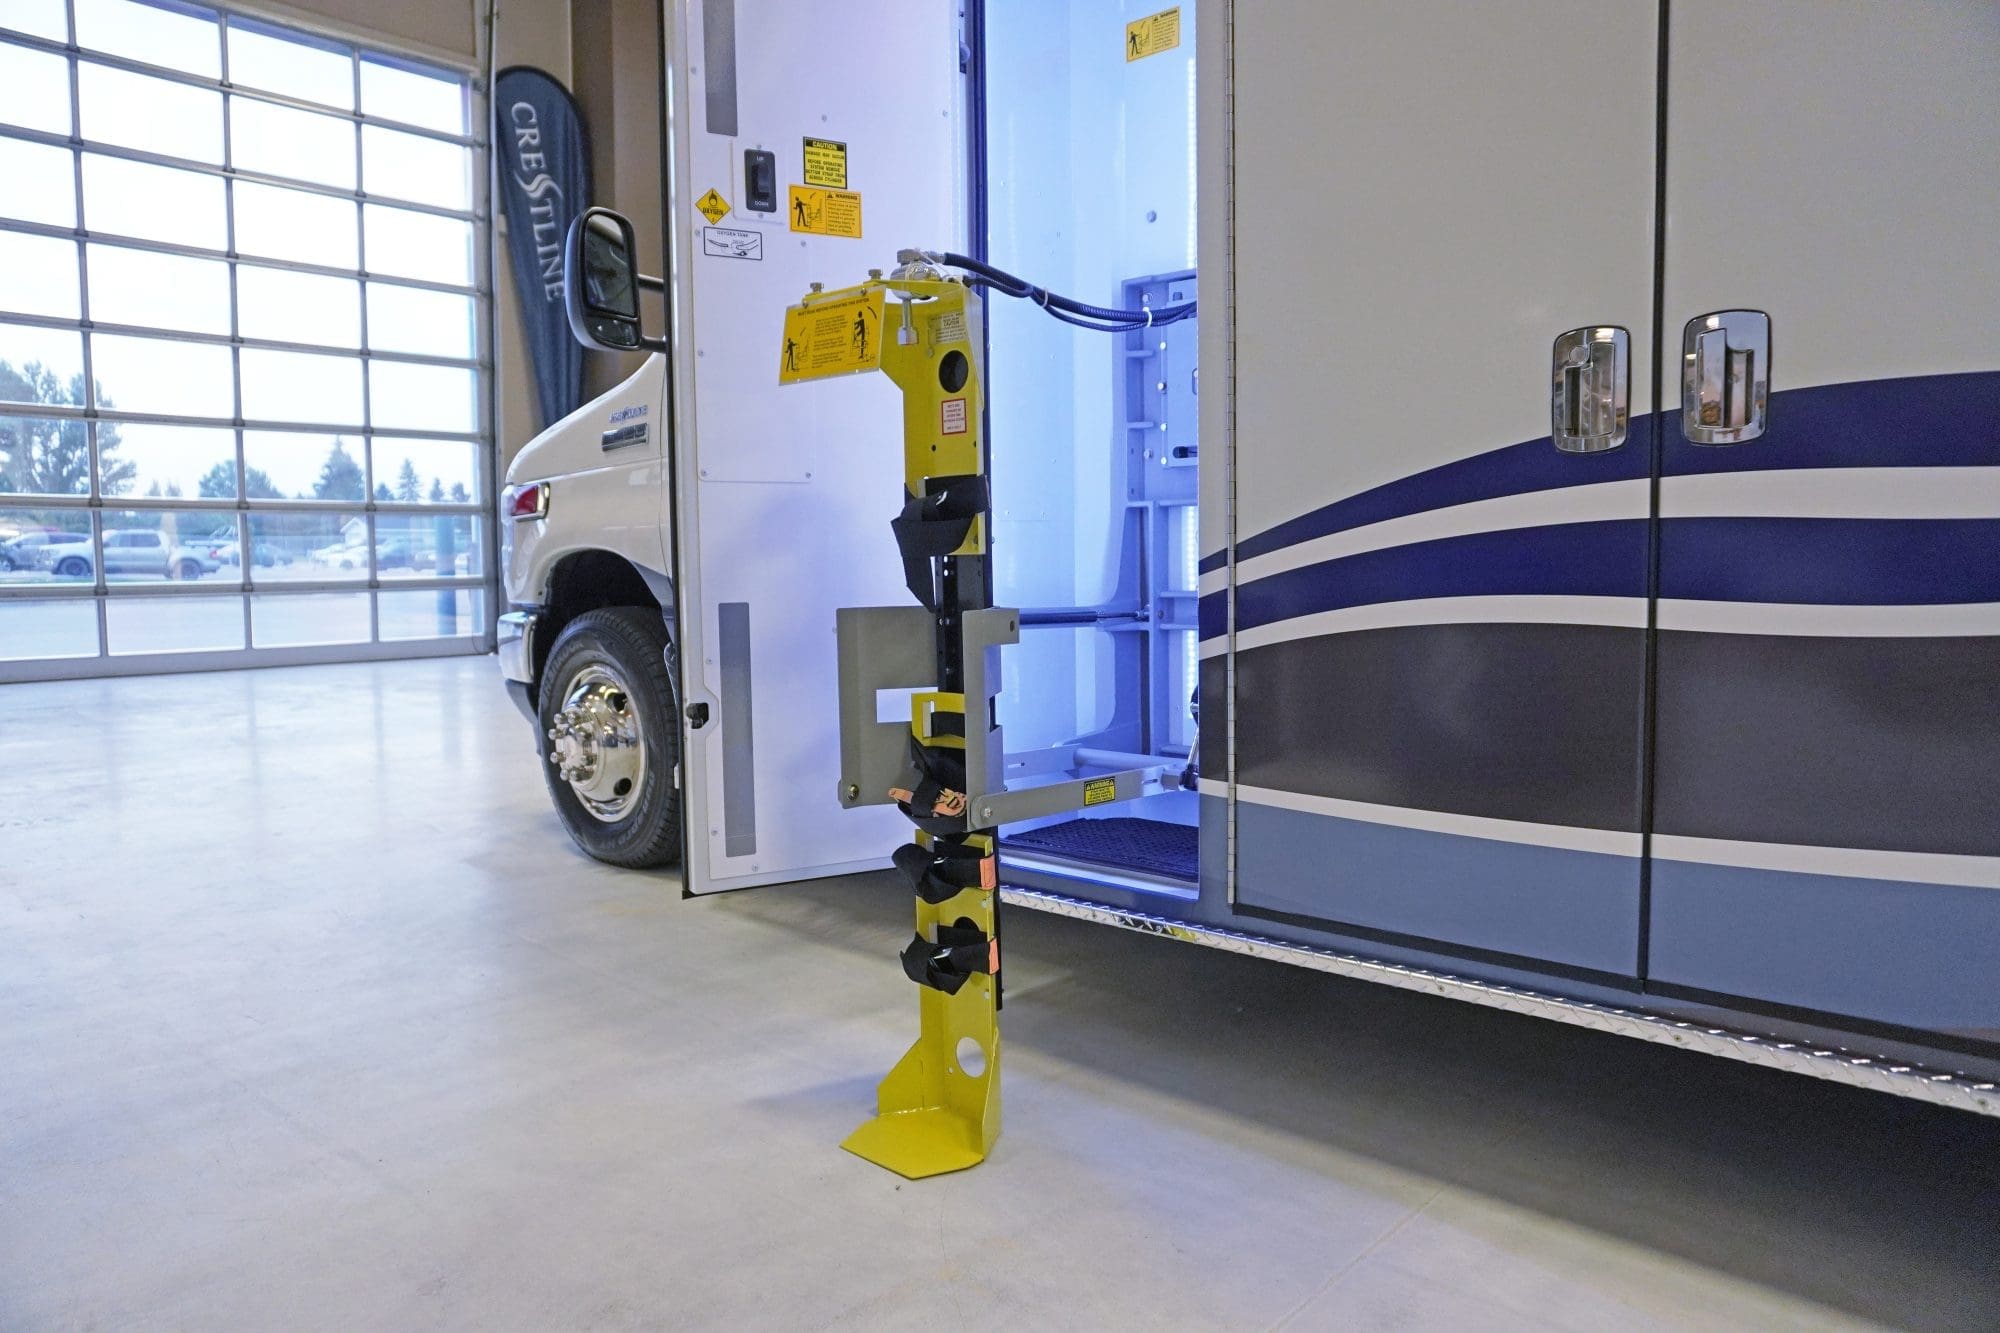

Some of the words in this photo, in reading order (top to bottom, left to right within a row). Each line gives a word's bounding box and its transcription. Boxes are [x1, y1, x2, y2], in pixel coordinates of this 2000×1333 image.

[812, 140, 837, 150] CAUTION
[511, 101, 565, 301] CRESTLINE
[702, 207, 724, 216] OXYGEN
